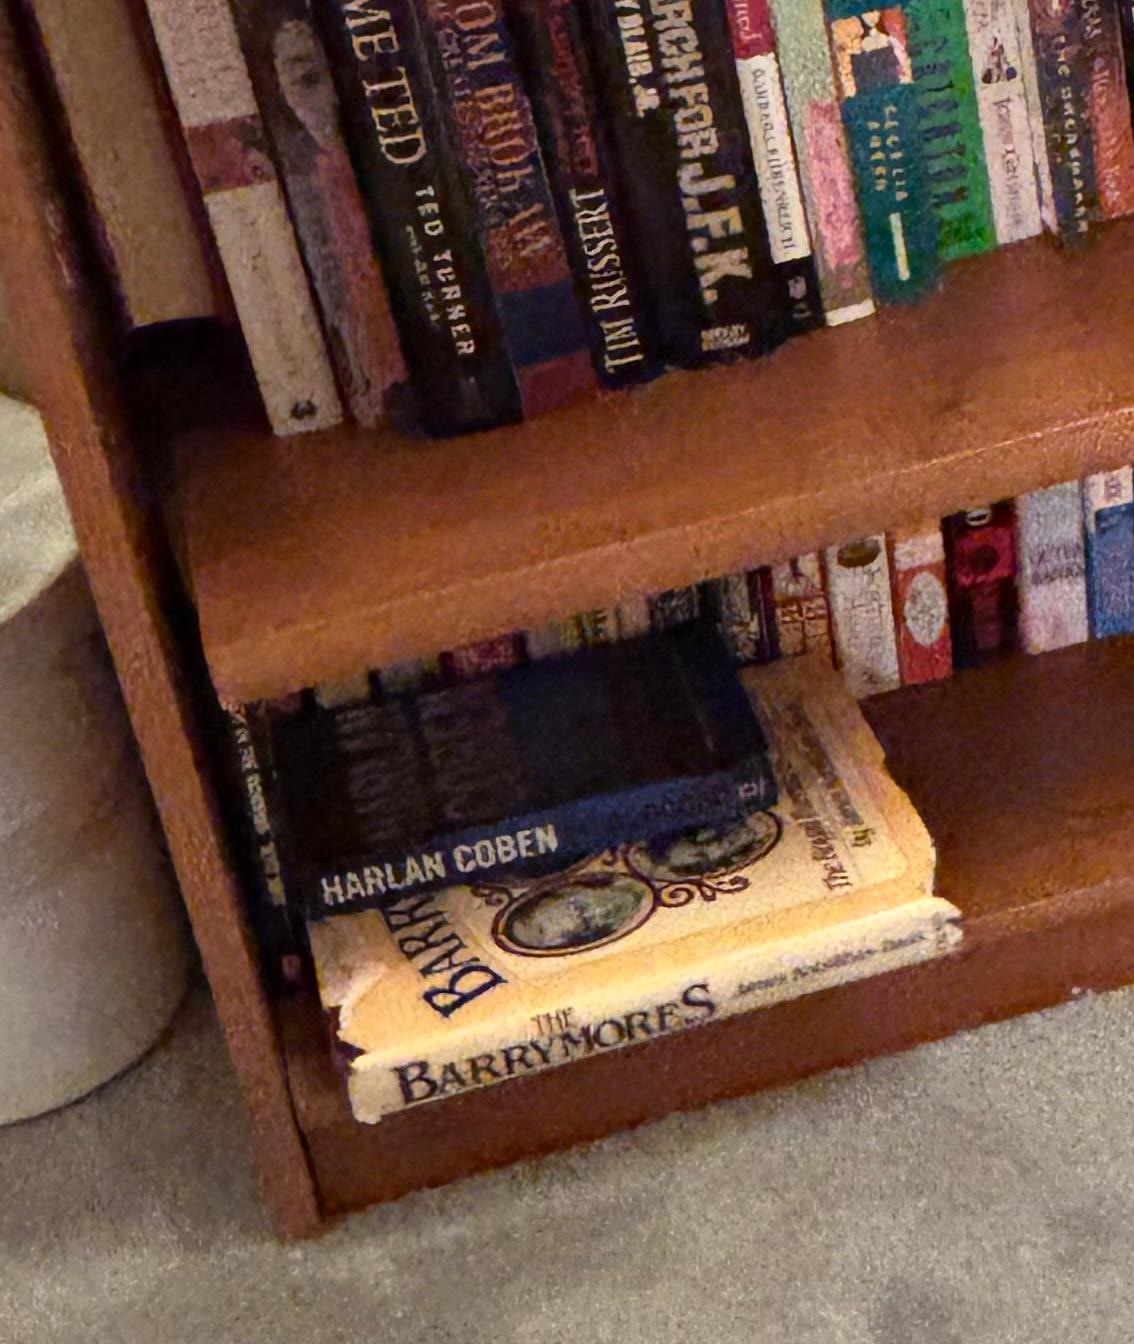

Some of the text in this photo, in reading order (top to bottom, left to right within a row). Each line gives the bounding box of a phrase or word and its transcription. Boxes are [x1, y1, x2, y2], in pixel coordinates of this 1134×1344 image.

[362, 67, 427, 164] TED
[667, 83, 719, 159] FOR
[415, 185, 445, 237] TED
[433, 249, 476, 356] TURNER
[569, 188, 631, 313] RUSSERT
[677, 162, 753, 306] J.F.K.
[601, 317, 644, 374] TIM
[320, 824, 559, 906] HARLAN COBEN
[386, 895, 508, 1019] BARR
[393, 982, 716, 1104] BARRYMORES
[532, 1006, 574, 1039] THE
